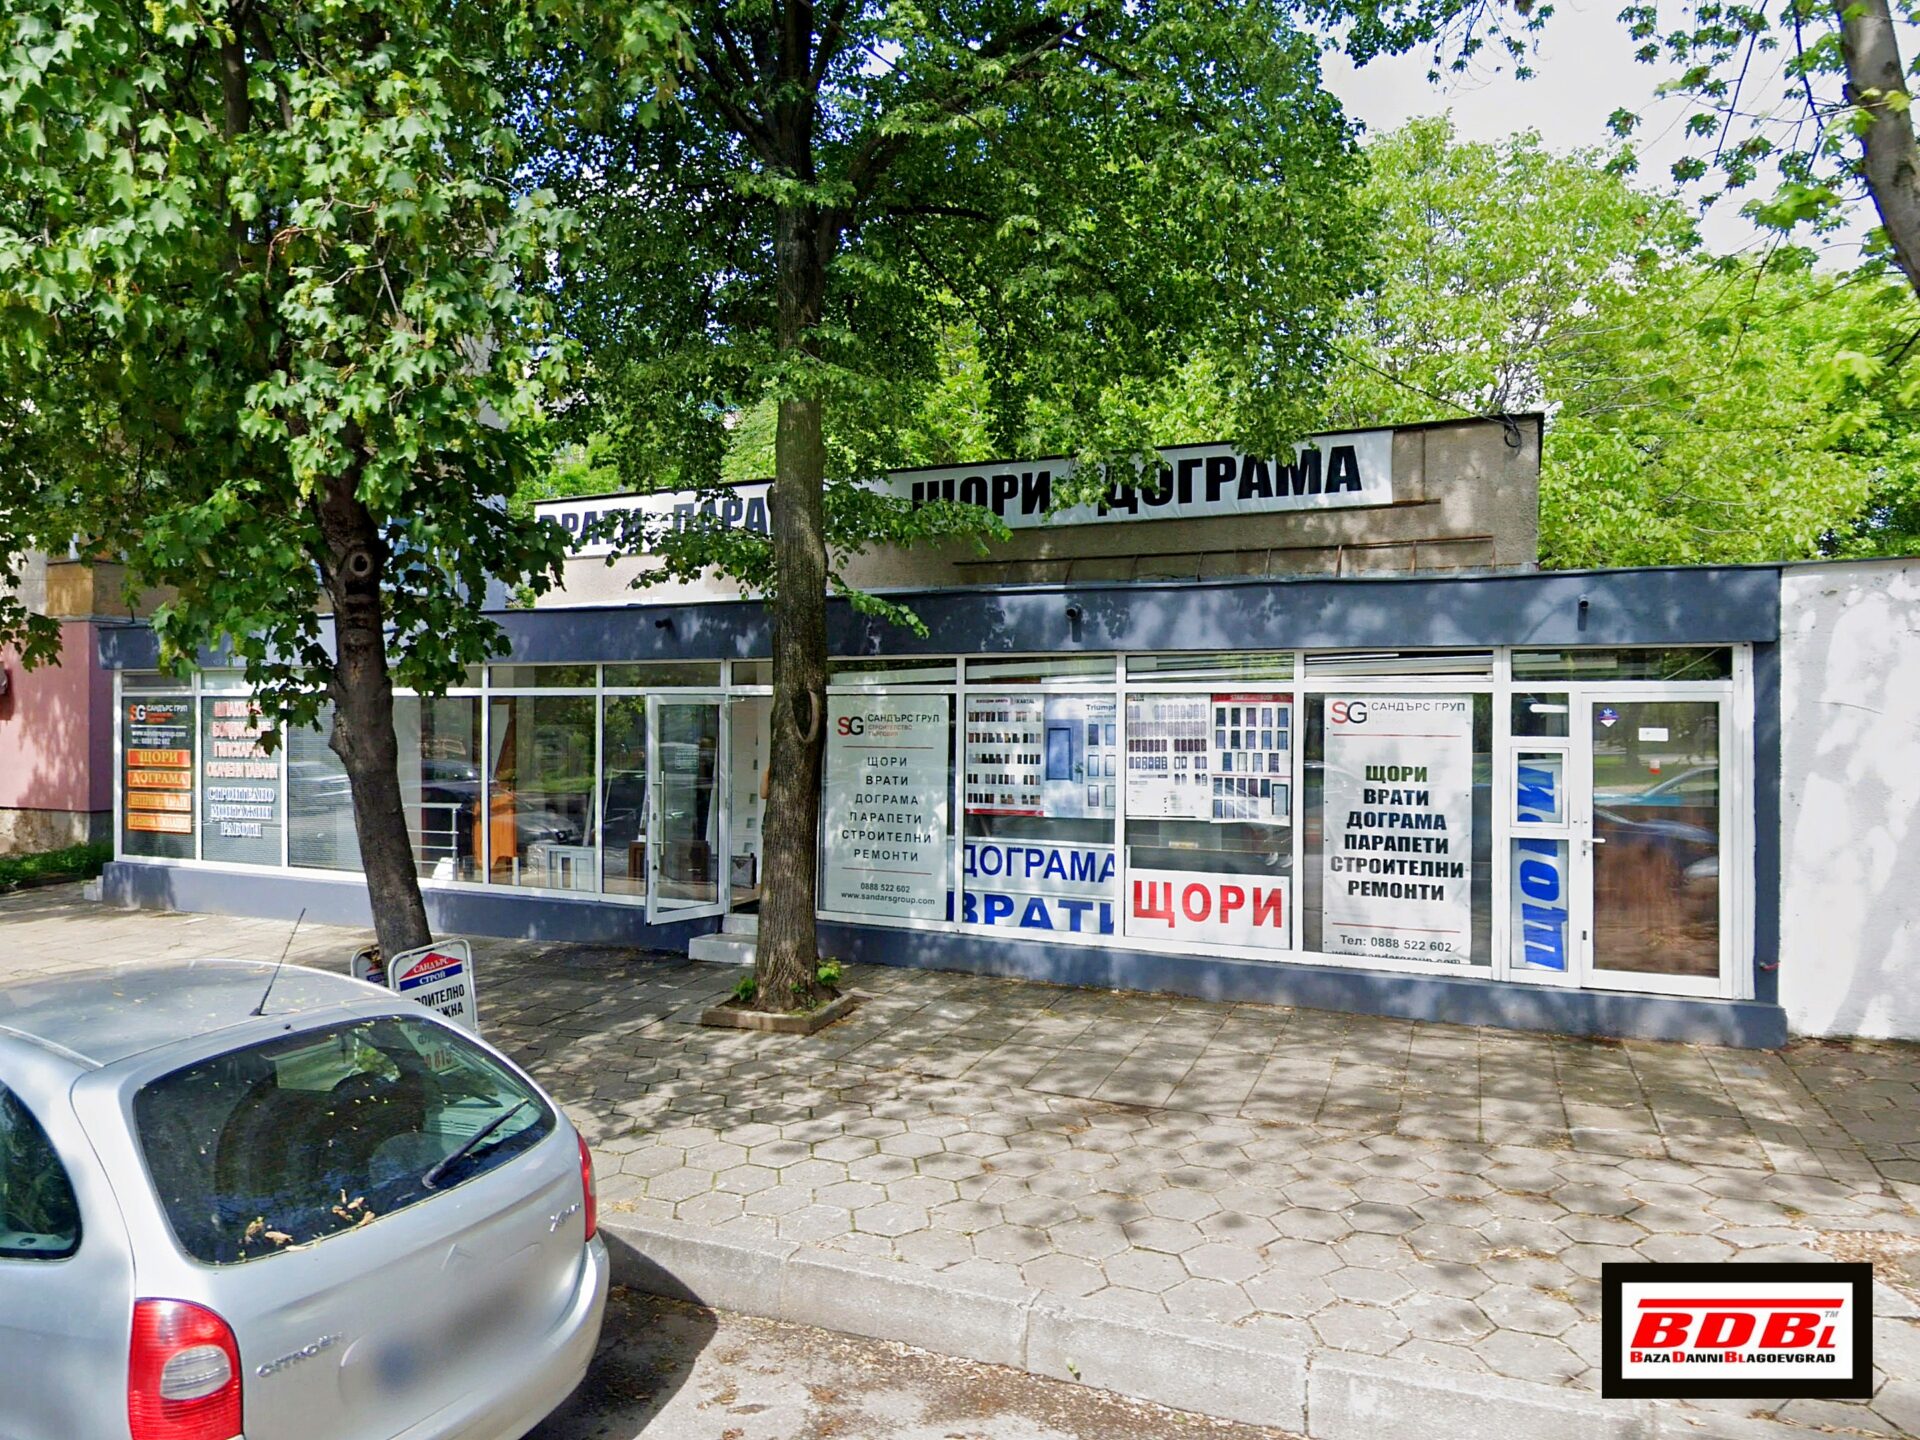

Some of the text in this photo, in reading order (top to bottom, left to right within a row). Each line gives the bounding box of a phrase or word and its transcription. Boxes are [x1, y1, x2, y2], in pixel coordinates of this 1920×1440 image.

[1098, 445, 1362, 516] ДОГРАМА
[128, 703, 146, 722] SG
[1331, 701, 1367, 724] SG
[1371, 702, 1465, 711] САНДЪРС ГРУП
[838, 716, 864, 736] SG
[867, 713, 940, 723] САНДЪРС ГРУП
[139, 751, 179, 764] ЩОРИ
[867, 756, 907, 768] ЩОРИ
[132, 772, 187, 785] ДОГРАМА
[866, 775, 908, 786] ВРАТИ
[1365, 765, 1428, 783] ЩОРИ
[855, 793, 919, 805] ДОГРАМА
[1363, 788, 1429, 806] ВРАТИ
[850, 811, 922, 824] ПАРАПЕТИ
[1346, 811, 1447, 830] ДОГРАМА
[842, 829, 931, 844] СТРОИТЕЛНИ
[1344, 834, 1449, 854] ПАРАПЕТИ
[854, 848, 918, 861] РЕМОНТИ
[964, 844, 1115, 883] ДОГРАМА
[1330, 856, 1464, 878] СТРОИТЕЛНИ
[860, 882, 910, 893] 0888 522 602
[1348, 880, 1444, 901] РЕМОНТИ
[1133, 880, 1282, 928] ЩОРИ
[1340, 935, 1452, 952] Тел: 0888 522 602
[413, 957, 449, 974] САНДЪРС
[419, 971, 446, 984] СТРОЙ
[414, 983, 465, 1007] ОИТЕЛНО
[436, 1002, 464, 1018] ЖНА
